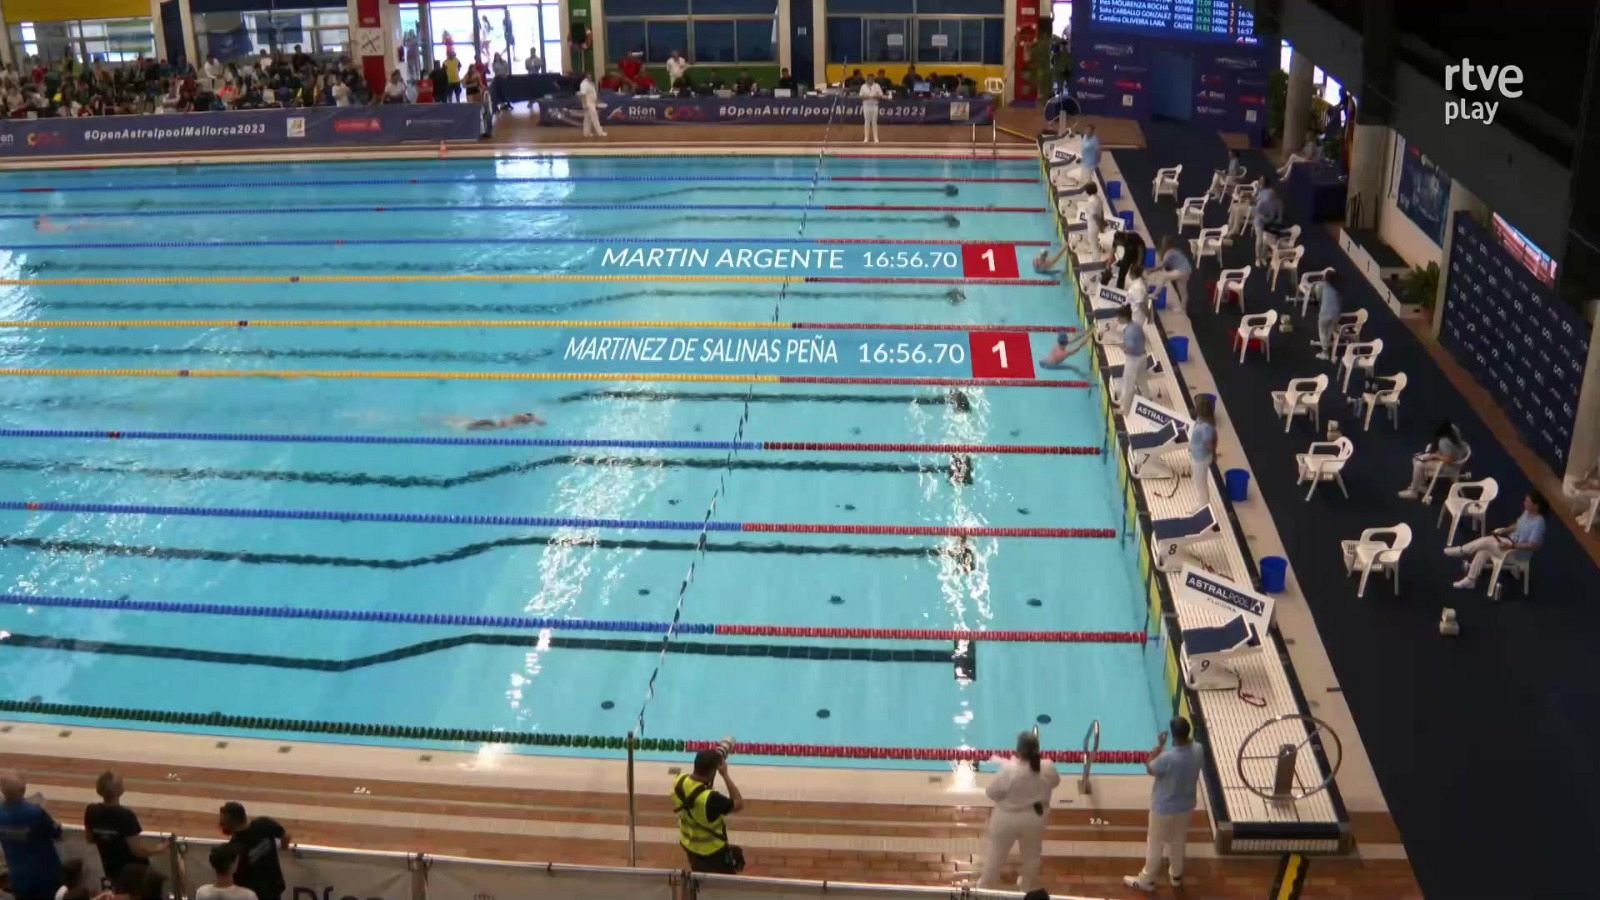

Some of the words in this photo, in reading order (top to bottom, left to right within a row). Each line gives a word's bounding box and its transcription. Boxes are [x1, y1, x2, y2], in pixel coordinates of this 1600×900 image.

[719, 104, 926, 117] #OpenAstralpooMallca2023
[84, 123, 266, 141] #OpenAstralpoolMallorca2023
[1141, 453, 1150, 465] 7
[1168, 543, 1177, 556] 8
[1200, 659, 1210, 672] 9
